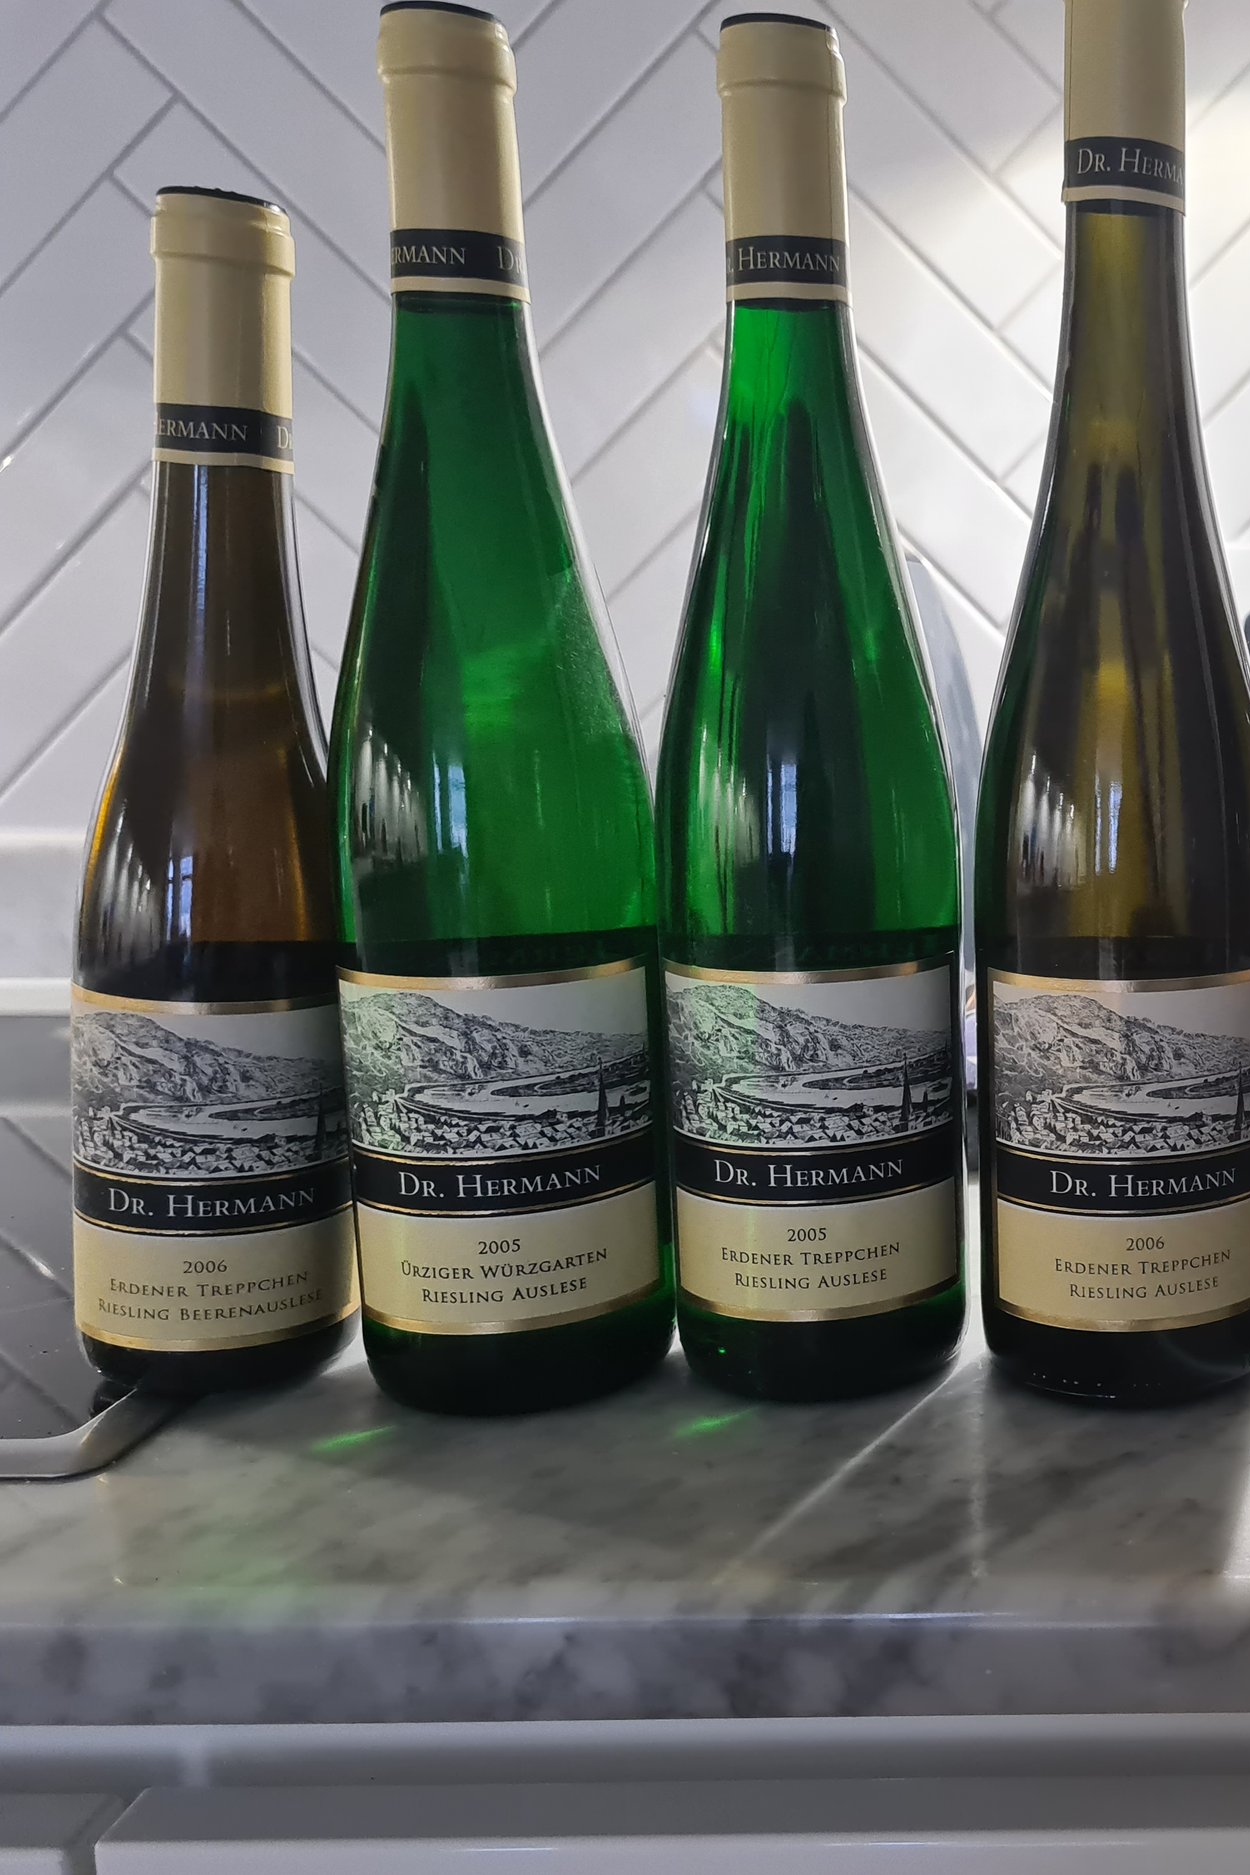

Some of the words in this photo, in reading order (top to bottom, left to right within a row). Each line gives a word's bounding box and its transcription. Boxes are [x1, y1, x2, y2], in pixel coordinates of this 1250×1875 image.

[1077, 148, 1110, 174] DR.
[738, 247, 840, 272] HERMANN
[399, 1171, 444, 1199] DR.
[457, 1164, 601, 1199] HERMANN
[713, 1160, 757, 1186] DR.
[768, 1159, 903, 1188] HERMANN
[1049, 1170, 1096, 1197] DR.
[1109, 1168, 1236, 1198] HERMANN
[108, 1188, 154, 1217] DR.
[167, 1186, 315, 1218] HERMANN
[478, 1239, 521, 1255] 2005
[787, 1228, 827, 1242] 2005
[1126, 1237, 1165, 1251] 2006
[182, 1259, 227, 1274] 2006
[401, 1259, 474, 1280] ÜRZIGER
[479, 1247, 608, 1279] WÜRZGARTEN
[721, 1247, 794, 1266] ERDENER
[801, 1241, 901, 1266] TREPPCHEN
[1054, 1258, 1132, 1276] ERDENER
[1137, 1249, 1231, 1276] TREPPCHEN
[110, 1279, 188, 1298] ERDENER
[197, 1271, 309, 1297] TREPPCHEN
[421, 1287, 503, 1304] RIESLING
[512, 1275, 587, 1302] AUSLESE
[734, 1273, 810, 1289] RIESLING
[817, 1268, 887, 1288] AUSLESE
[1069, 1283, 1147, 1299] RIESLING
[1154, 1276, 1219, 1297] AUSLESE
[98, 1298, 170, 1321] RIESLING
[180, 1288, 323, 1321] BEERENAUSLESE
